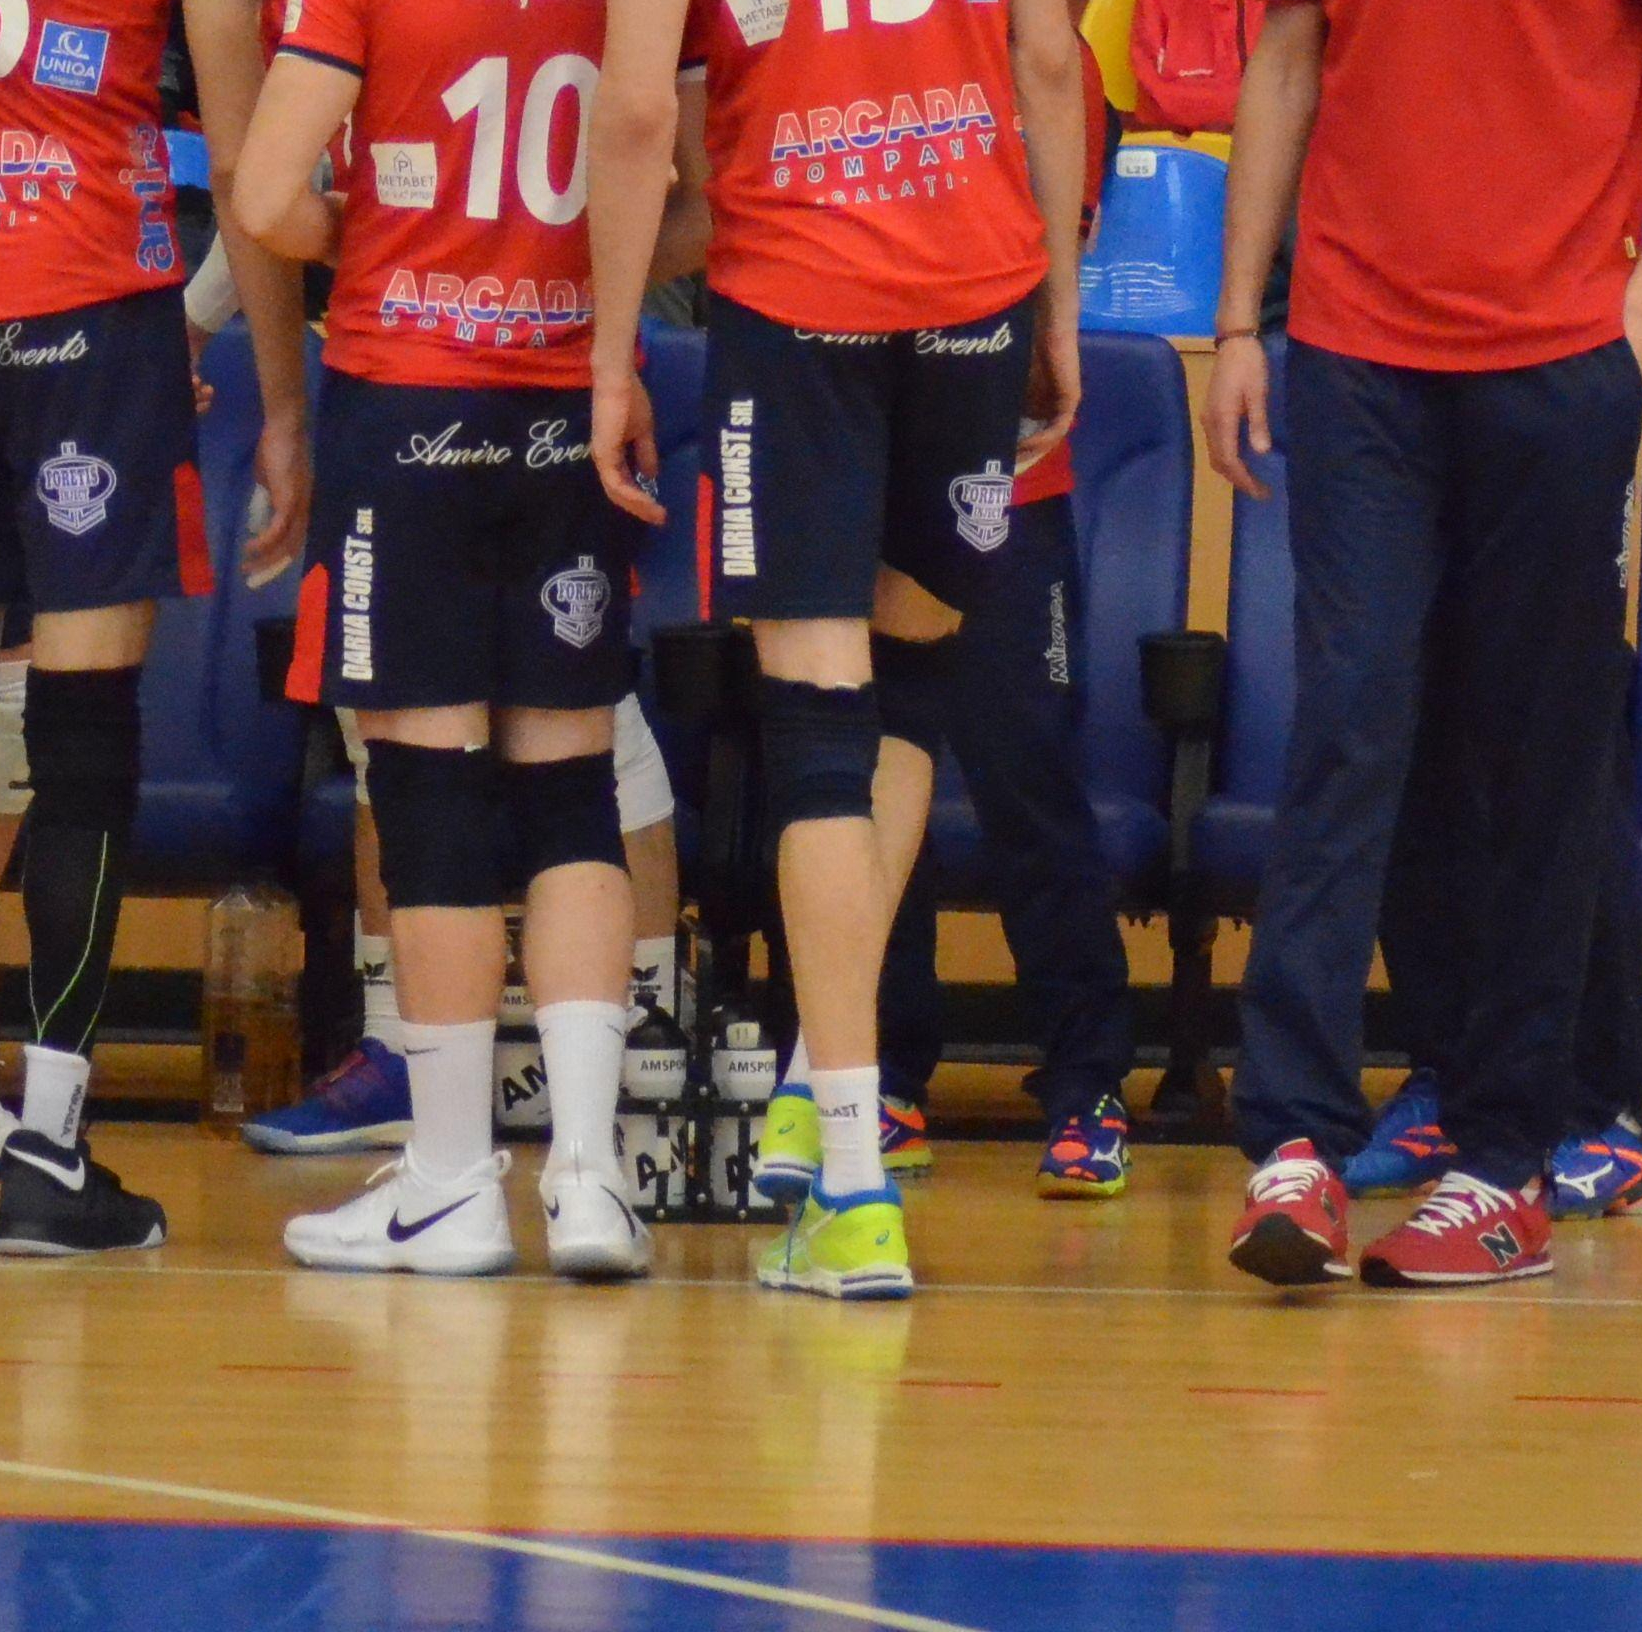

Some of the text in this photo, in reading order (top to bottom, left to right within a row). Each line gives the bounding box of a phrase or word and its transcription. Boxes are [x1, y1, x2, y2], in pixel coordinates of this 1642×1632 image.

[39, 55, 97, 80] UNIQA
[441, 54, 600, 226] 10
[770, 82, 997, 162] ARCADA
[377, 174, 435, 189] METABET
[774, 132, 997, 188] COMPANY
[381, 314, 547, 348] COMPA
[915, 322, 1013, 354] Events
[397, 418, 593, 469] Amiro Even
[44, 465, 99, 489] FORETIS
[720, 429, 757, 576] DARIA CONST
[342, 536, 374, 681] DARIA CONST
[640, 1058, 686, 1072] AMSPO
[1478, 1221, 1522, 1268] N
